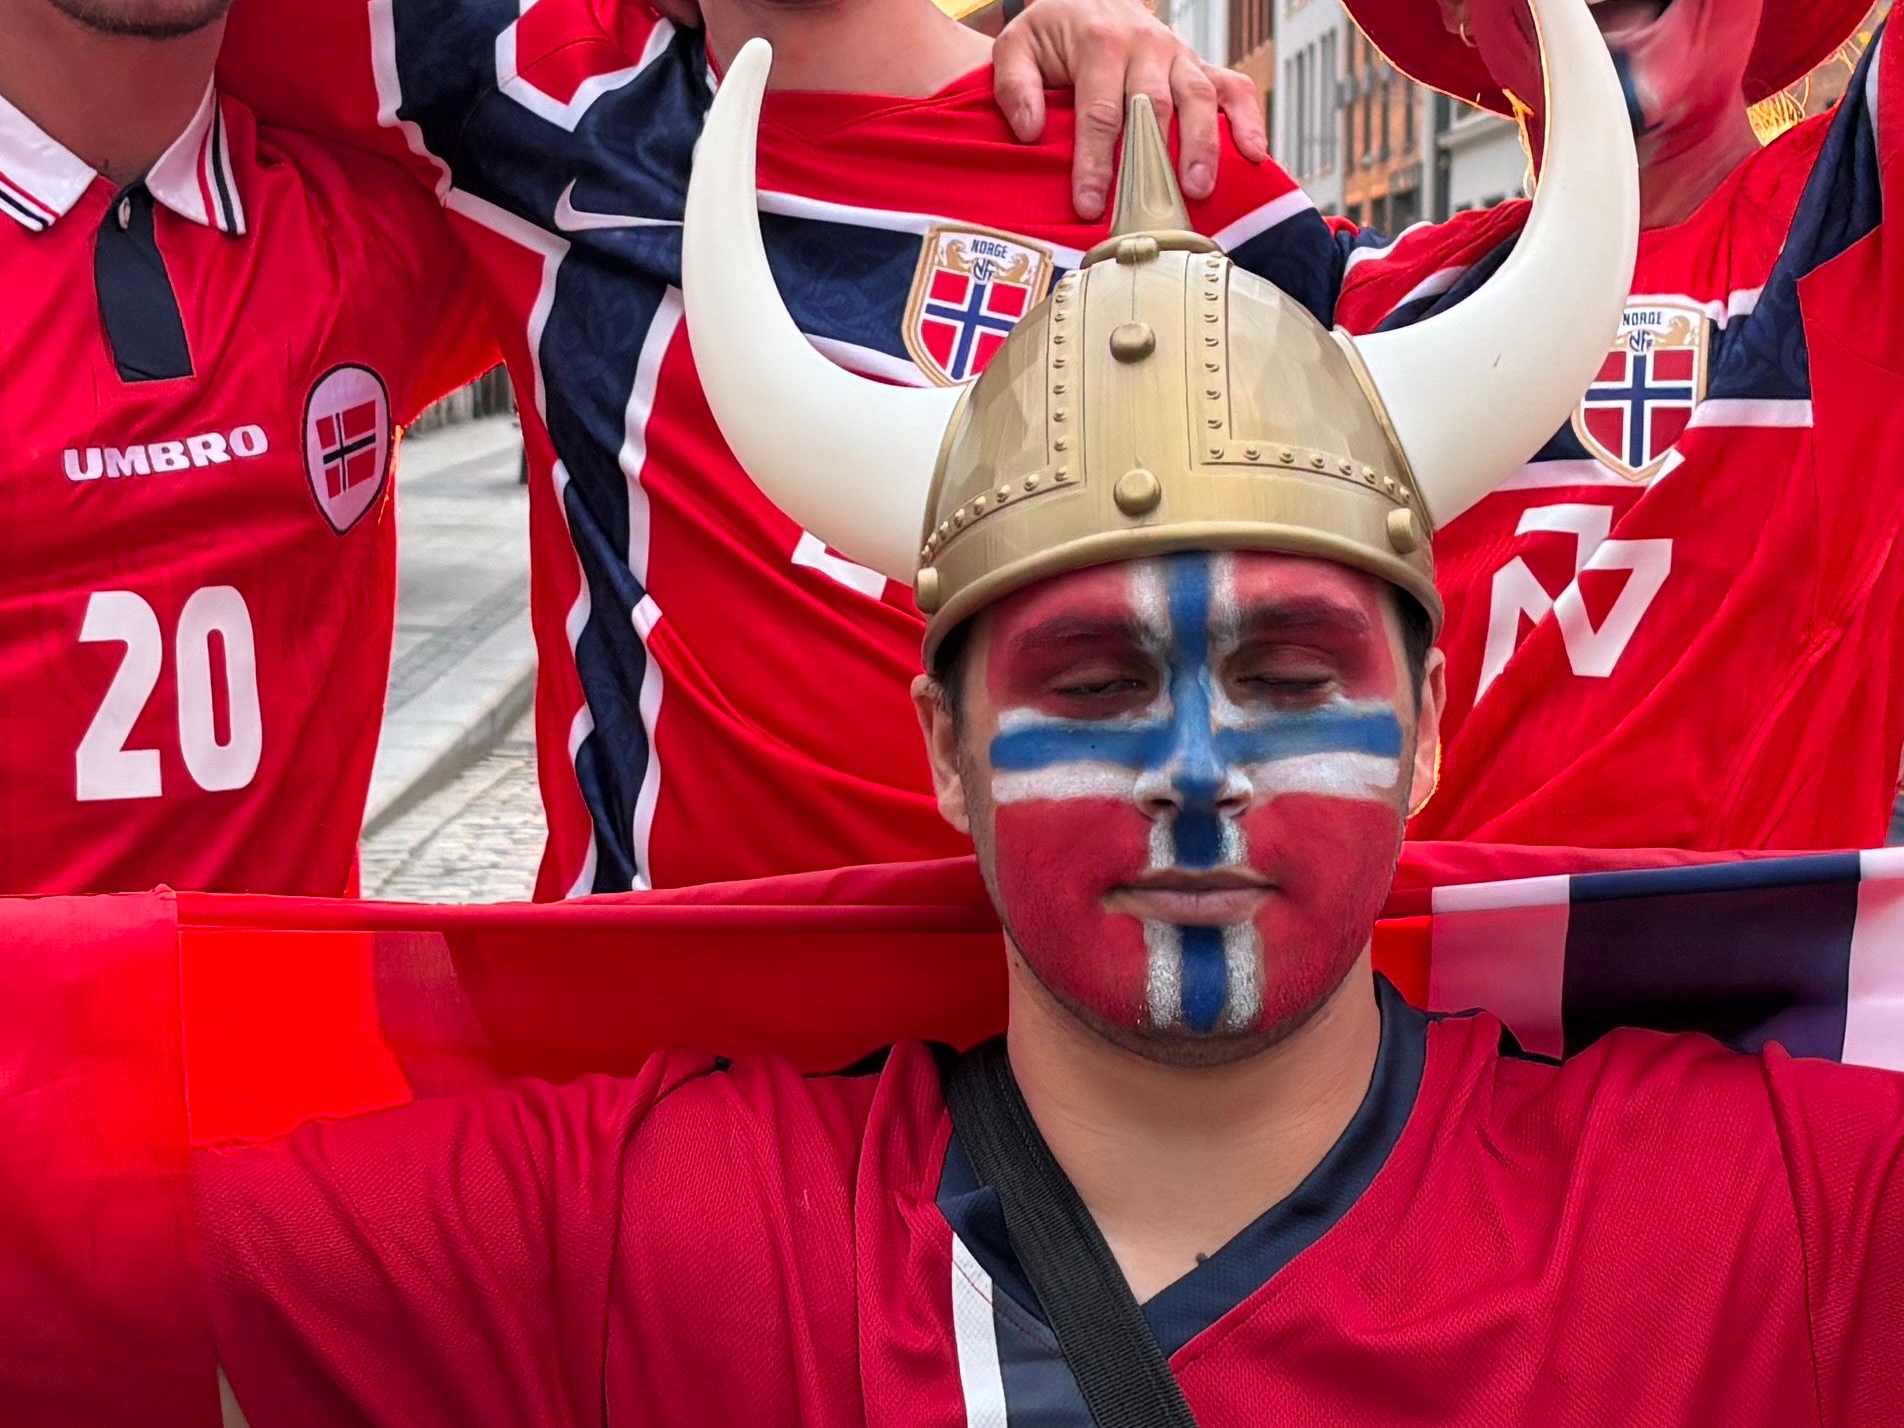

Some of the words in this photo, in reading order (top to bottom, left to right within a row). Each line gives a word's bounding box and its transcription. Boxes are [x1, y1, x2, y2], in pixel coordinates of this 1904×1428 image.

[970, 238, 1008, 259] NORGE
[1622, 311, 1662, 326] NORGE
[63, 424, 269, 483] UMBRO
[74, 584, 263, 802] 20
